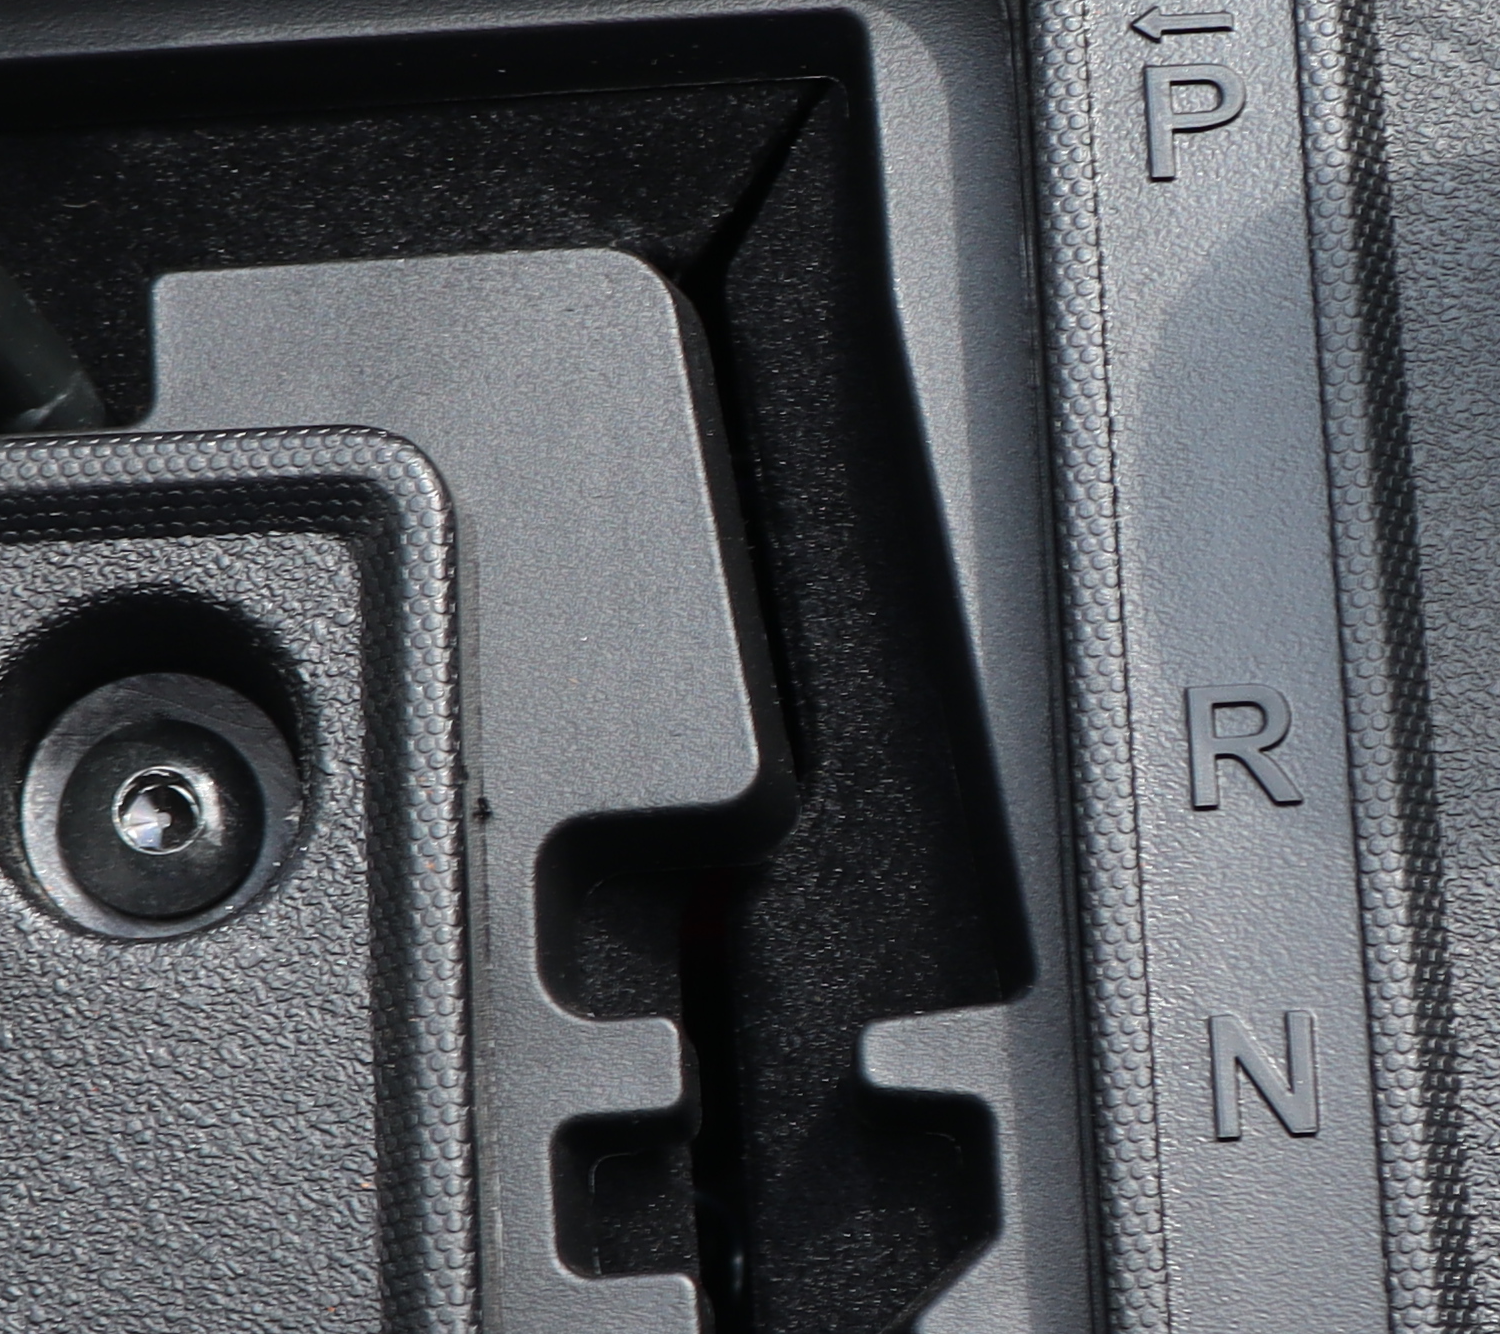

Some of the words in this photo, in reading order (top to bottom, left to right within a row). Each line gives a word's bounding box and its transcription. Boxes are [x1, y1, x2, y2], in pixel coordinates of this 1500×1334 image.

[1142, 64, 1245, 183] P
[1184, 683, 1302, 811] R
[1208, 1009, 1320, 1142] N
